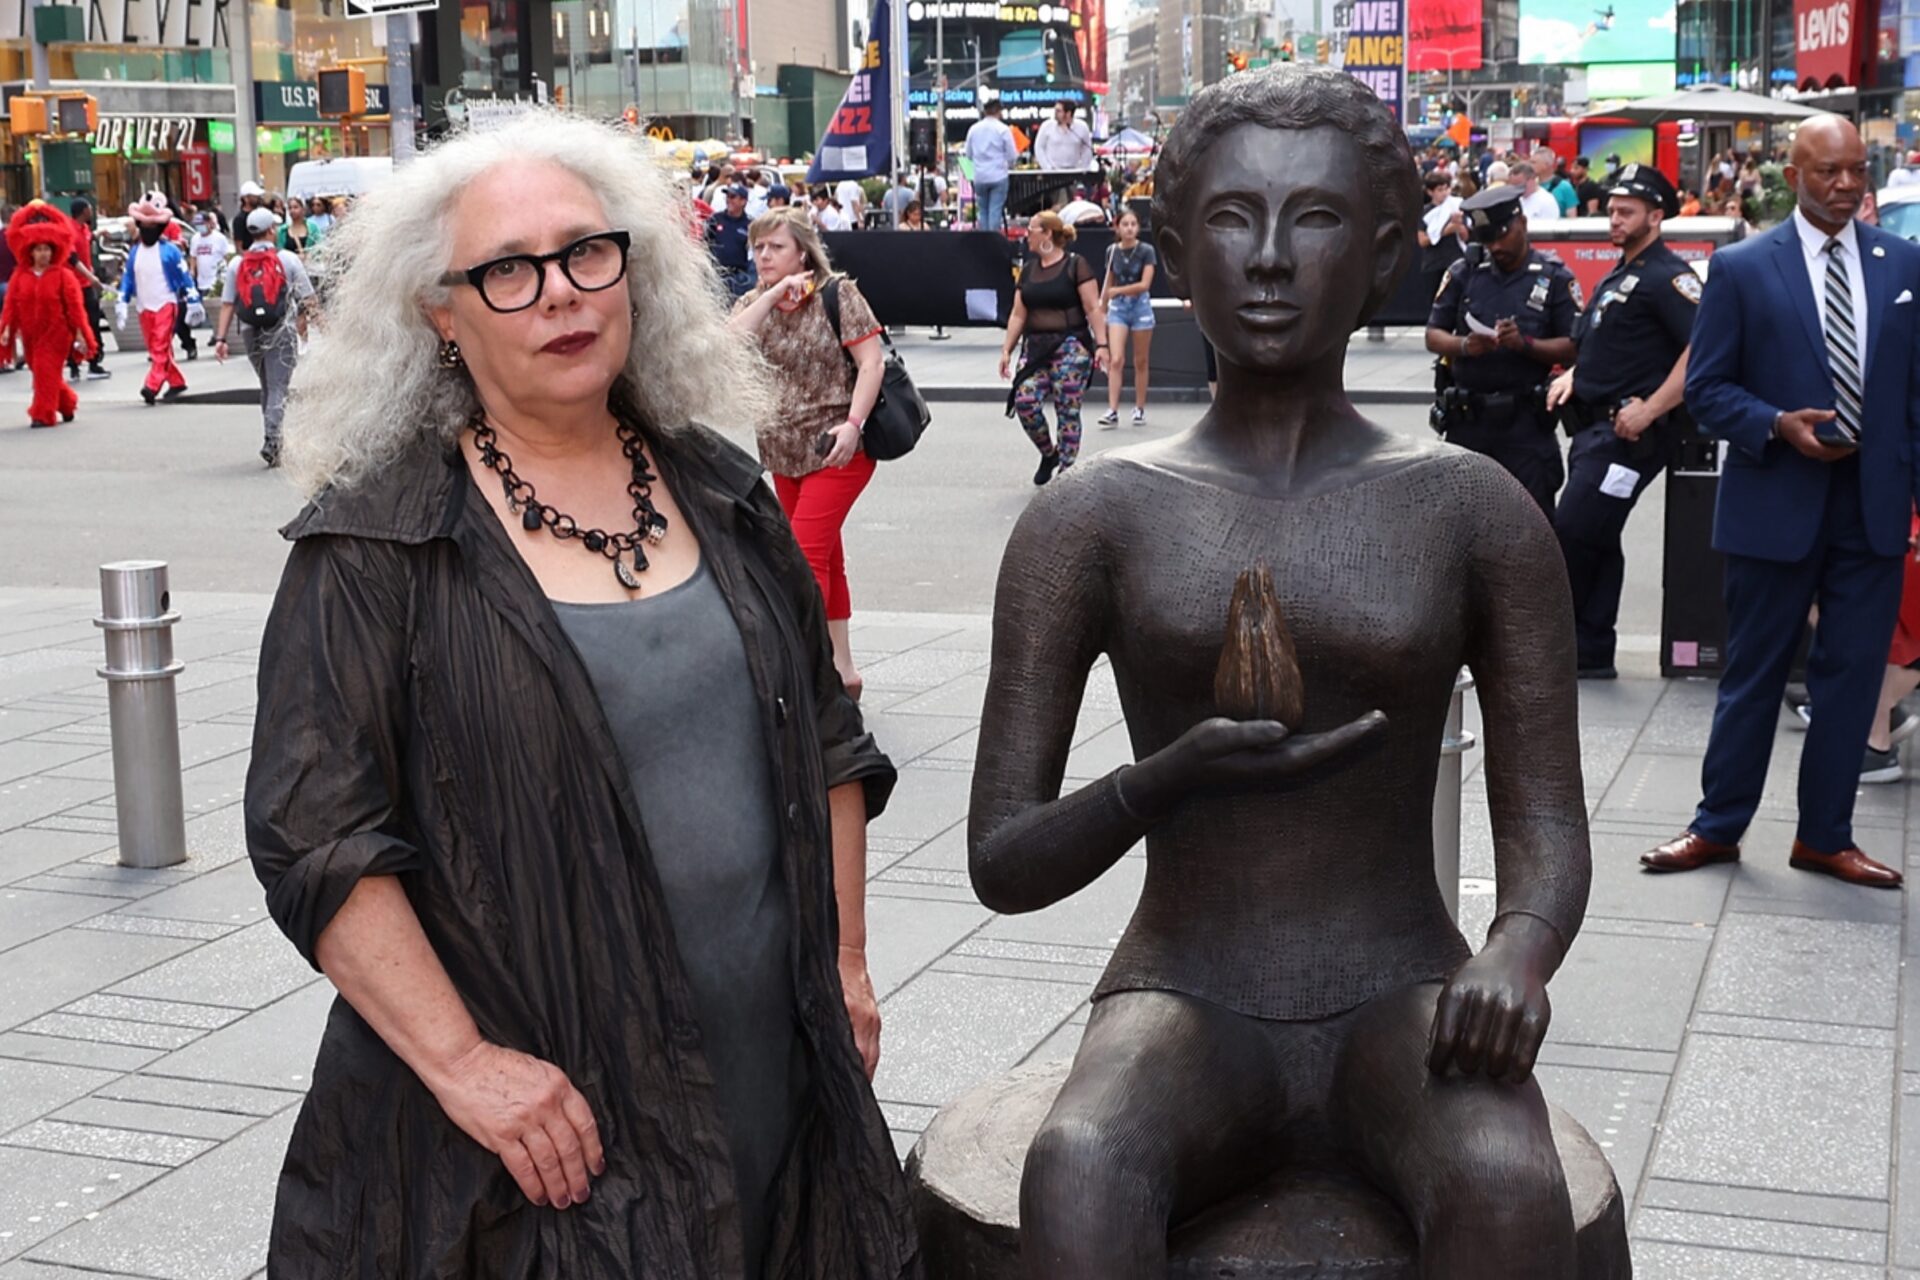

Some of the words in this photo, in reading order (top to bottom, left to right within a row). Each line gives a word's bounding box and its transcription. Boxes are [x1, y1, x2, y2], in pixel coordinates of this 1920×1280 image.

[281, 86, 304, 107] U.S.
[92, 117, 171, 150] OREVER
[176, 118, 196, 150] 21
